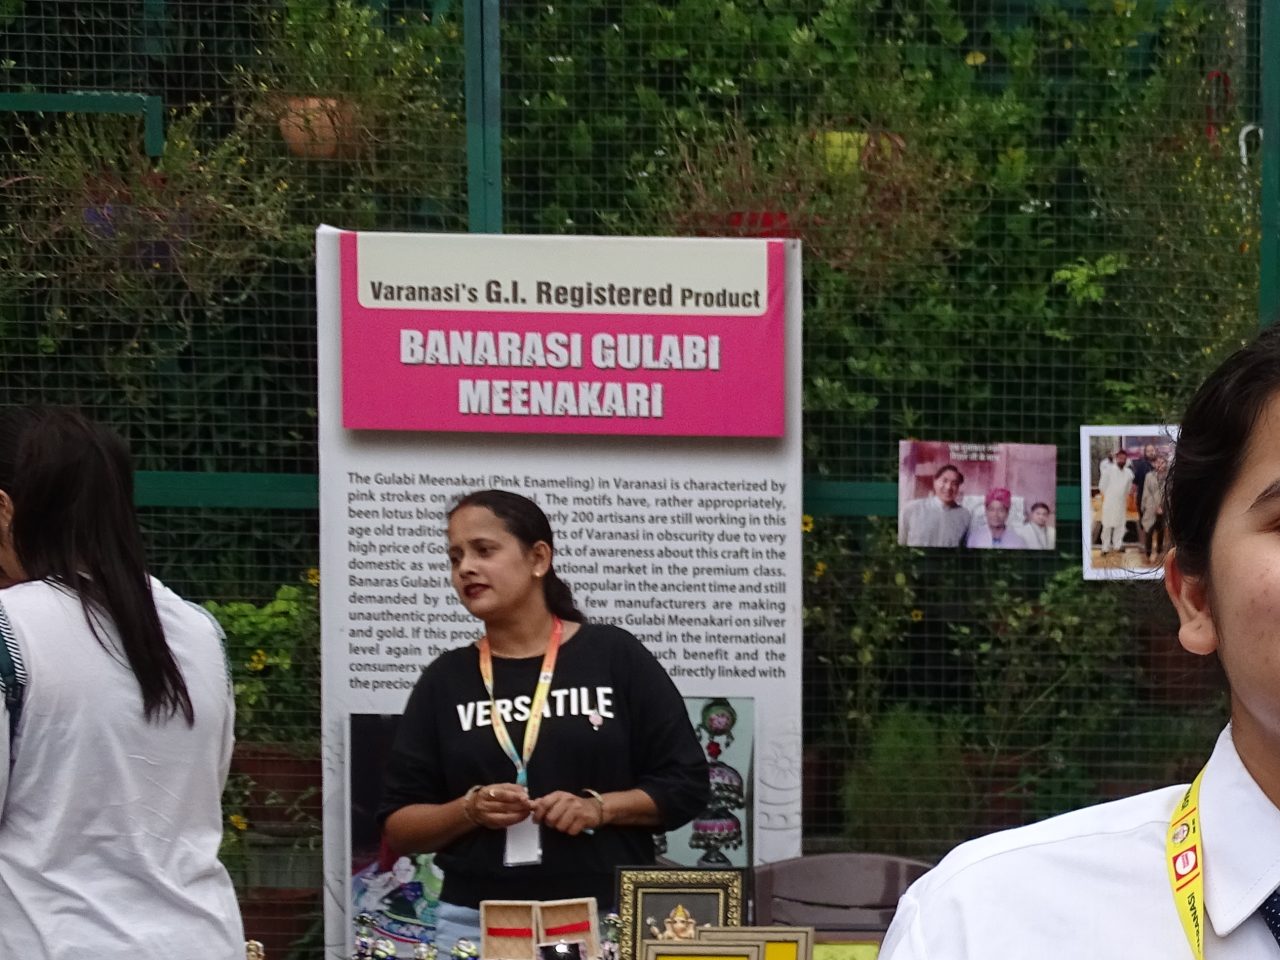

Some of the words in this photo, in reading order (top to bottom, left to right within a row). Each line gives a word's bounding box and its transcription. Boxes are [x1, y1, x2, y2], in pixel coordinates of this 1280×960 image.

[370, 280, 478, 303] Varanasi's
[485, 279, 527, 304] G.I.
[536, 281, 673, 308] Registered
[680, 287, 760, 309] Product
[400, 328, 583, 369] BANARASI
[591, 332, 720, 371] GULABI
[458, 378, 664, 419] MEENAKARI
[348, 472, 371, 485] The
[374, 473, 416, 486] Gulabi
[419, 474, 486, 487] Meenakari
[489, 475, 520, 488] (Pink
[524, 476, 595, 492] Enameling)
[598, 478, 610, 489] in
[613, 478, 667, 490] Varanasi
[670, 478, 680, 490] is
[683, 478, 767, 492] characterized
[771, 478, 786, 494] by
[348, 490, 376, 504] pink
[380, 490, 425, 503] strokes
[430, 493, 447, 503] on
[545, 493, 568, 506] The
[572, 493, 612, 506] motifs
[655, 496, 693, 508] rather
[348, 507, 379, 519] been
[382, 507, 413, 519] lotus
[572, 511, 594, 523] 200
[596, 512, 645, 524] artisans
[648, 515, 668, 525] are
[670, 513, 693, 525] still
[695, 514, 747, 528] working
[749, 515, 761, 526] in
[763, 514, 786, 526] this
[348, 527, 371, 538] age
[374, 524, 394, 536] old
[570, 529, 584, 540] of
[585, 528, 640, 540] Varanasi
[642, 530, 654, 541] in
[656, 530, 715, 545] obscurity
[717, 531, 741, 543] due
[743, 532, 756, 543] to
[759, 534, 786, 546] very
[348, 541, 377, 555] high
[379, 542, 410, 555] price
[412, 542, 425, 554] of
[574, 545, 588, 557] of
[589, 547, 655, 559] awareness
[656, 547, 694, 559] about
[696, 547, 718, 559] this
[721, 547, 749, 560] craft
[751, 549, 763, 560] in
[765, 548, 786, 560] the
[348, 558, 406, 571] domestic
[410, 561, 424, 571] as
[602, 563, 647, 575] market
[651, 563, 663, 575] in
[667, 564, 688, 576] the
[692, 565, 749, 578] premium
[753, 565, 786, 577] class.
[348, 574, 399, 588] Banaras
[400, 575, 441, 588] Gulabi
[574, 579, 622, 593] popular
[624, 580, 636, 592] in
[638, 580, 658, 592] the
[660, 581, 706, 593] ancient
[708, 581, 737, 593] time
[738, 582, 762, 594] and
[763, 581, 786, 594] still
[348, 592, 417, 605] demanded
[423, 593, 440, 607] by
[585, 595, 608, 608] few
[614, 596, 706, 610] manufacturers
[712, 600, 733, 610] are
[738, 599, 786, 613] making
[348, 609, 425, 622] unauthentic
[625, 614, 665, 626] Gulabi
[667, 614, 733, 627] Meenakari
[734, 618, 751, 627] on
[753, 616, 786, 628] silver
[348, 627, 373, 639] and
[376, 627, 408, 641] gold.
[423, 627, 447, 640] this
[666, 631, 678, 643] in
[681, 631, 702, 643] the
[705, 632, 786, 645] international
[349, 643, 380, 655] level
[385, 645, 422, 659] again
[683, 648, 729, 660] benefit
[735, 649, 759, 661] and
[765, 650, 786, 661] the
[349, 662, 417, 673] consumers
[668, 665, 716, 680] directly
[717, 665, 756, 678] linked
[758, 666, 786, 679] with
[349, 678, 370, 689] the
